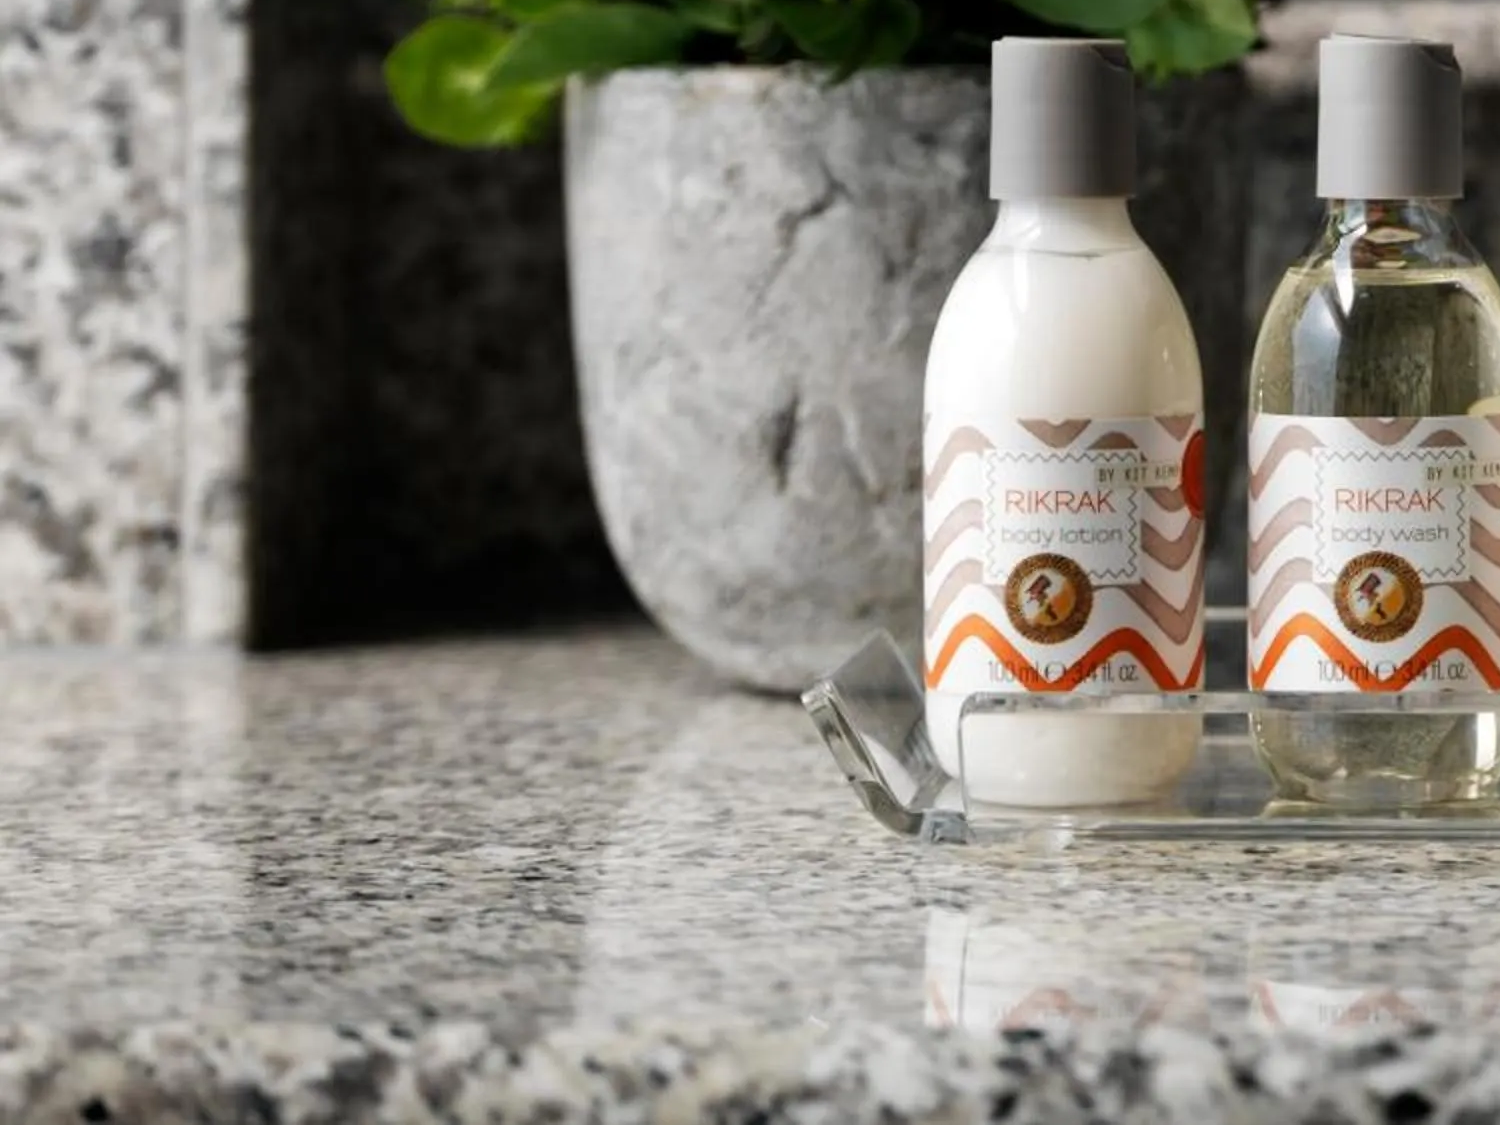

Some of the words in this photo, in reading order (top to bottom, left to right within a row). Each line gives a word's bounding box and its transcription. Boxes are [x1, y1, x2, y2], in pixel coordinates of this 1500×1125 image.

[1005, 489, 1116, 514] RIKRAK
[1335, 488, 1445, 513] RIKRAK
[1001, 527, 1054, 548] body
[1059, 527, 1123, 545] lotion
[1332, 525, 1385, 546] body
[1390, 525, 1449, 543] wash
[988, 660, 1014, 682] 100
[1019, 660, 1039, 682] ml
[1318, 659, 1345, 681] 100
[1348, 659, 1369, 681] ml
